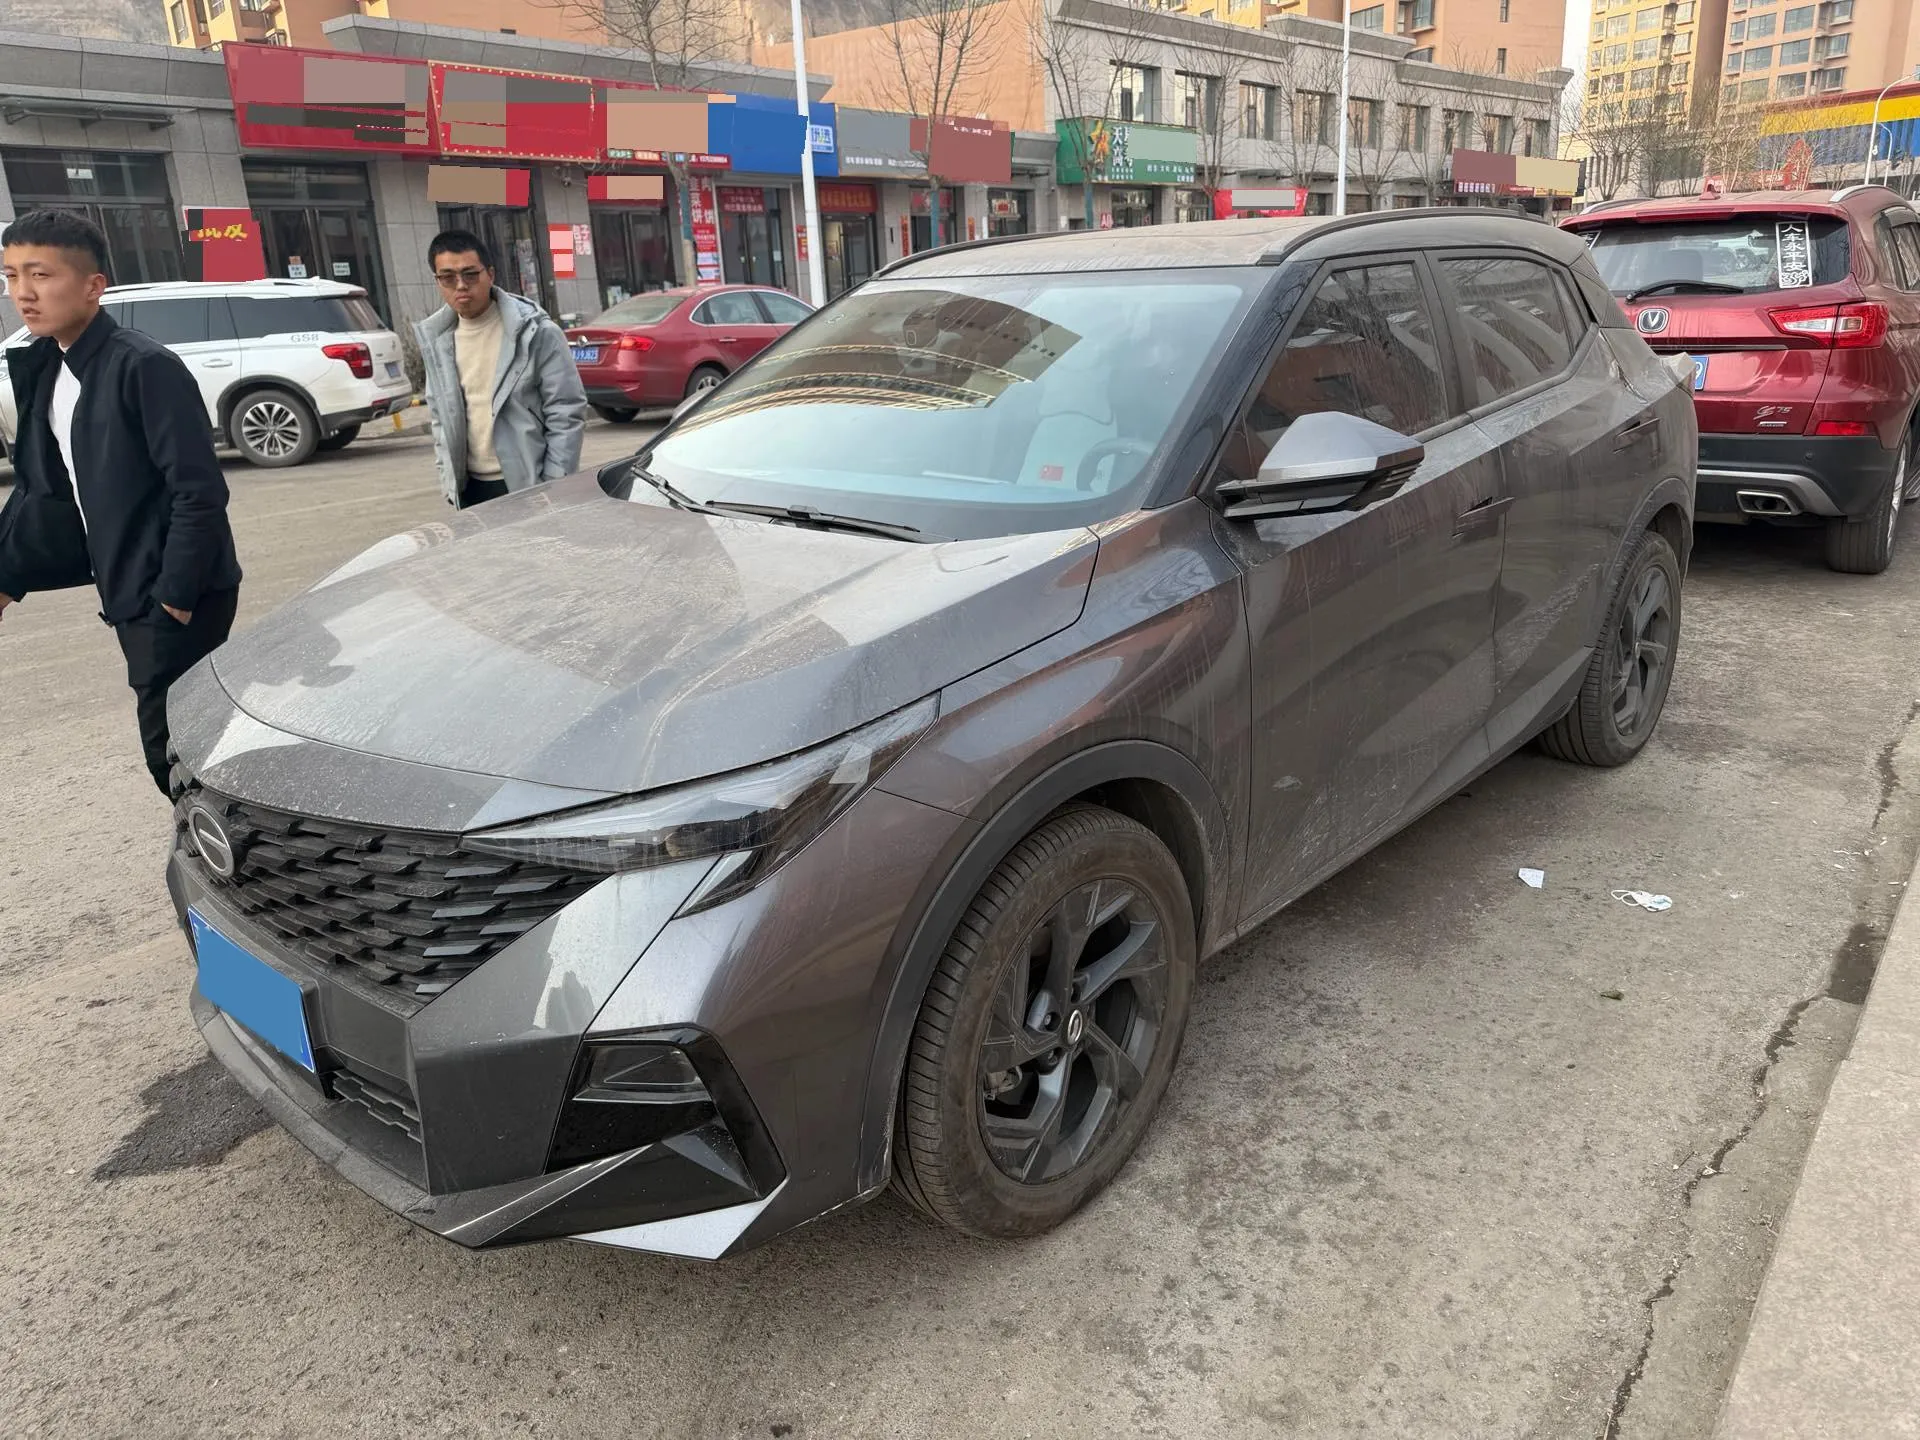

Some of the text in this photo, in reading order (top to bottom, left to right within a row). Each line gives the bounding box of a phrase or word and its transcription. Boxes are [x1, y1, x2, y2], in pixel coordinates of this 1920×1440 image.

[1781, 224, 1807, 272] 人车永平安
[290, 333, 320, 343] GS8
